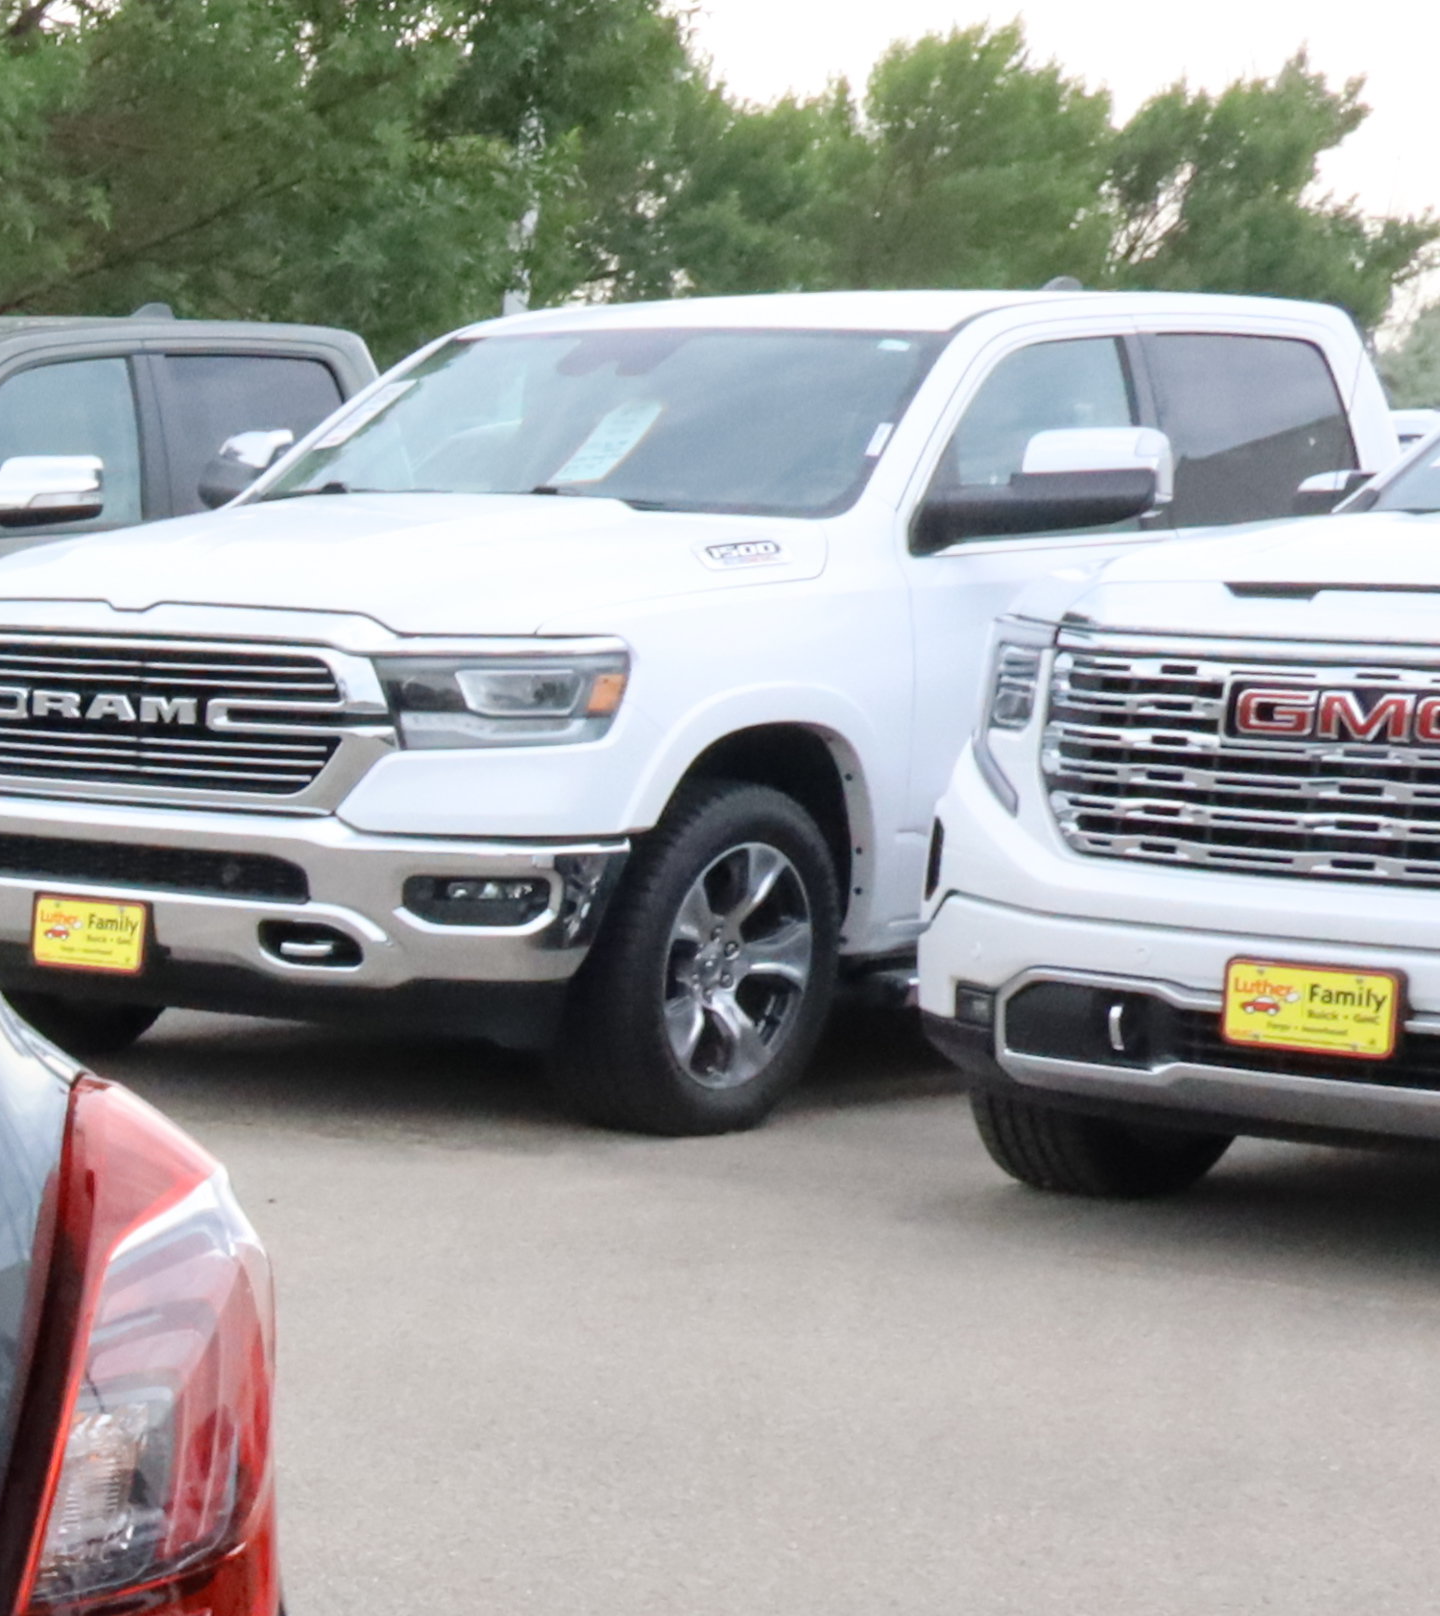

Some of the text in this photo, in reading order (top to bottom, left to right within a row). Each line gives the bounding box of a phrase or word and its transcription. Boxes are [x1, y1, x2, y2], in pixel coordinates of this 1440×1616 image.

[707, 541, 779, 560] 1500
[32, 689, 198, 725] RAM
[40, 908, 138, 937] Luther Family
[1234, 976, 1388, 1013] Luther Family
